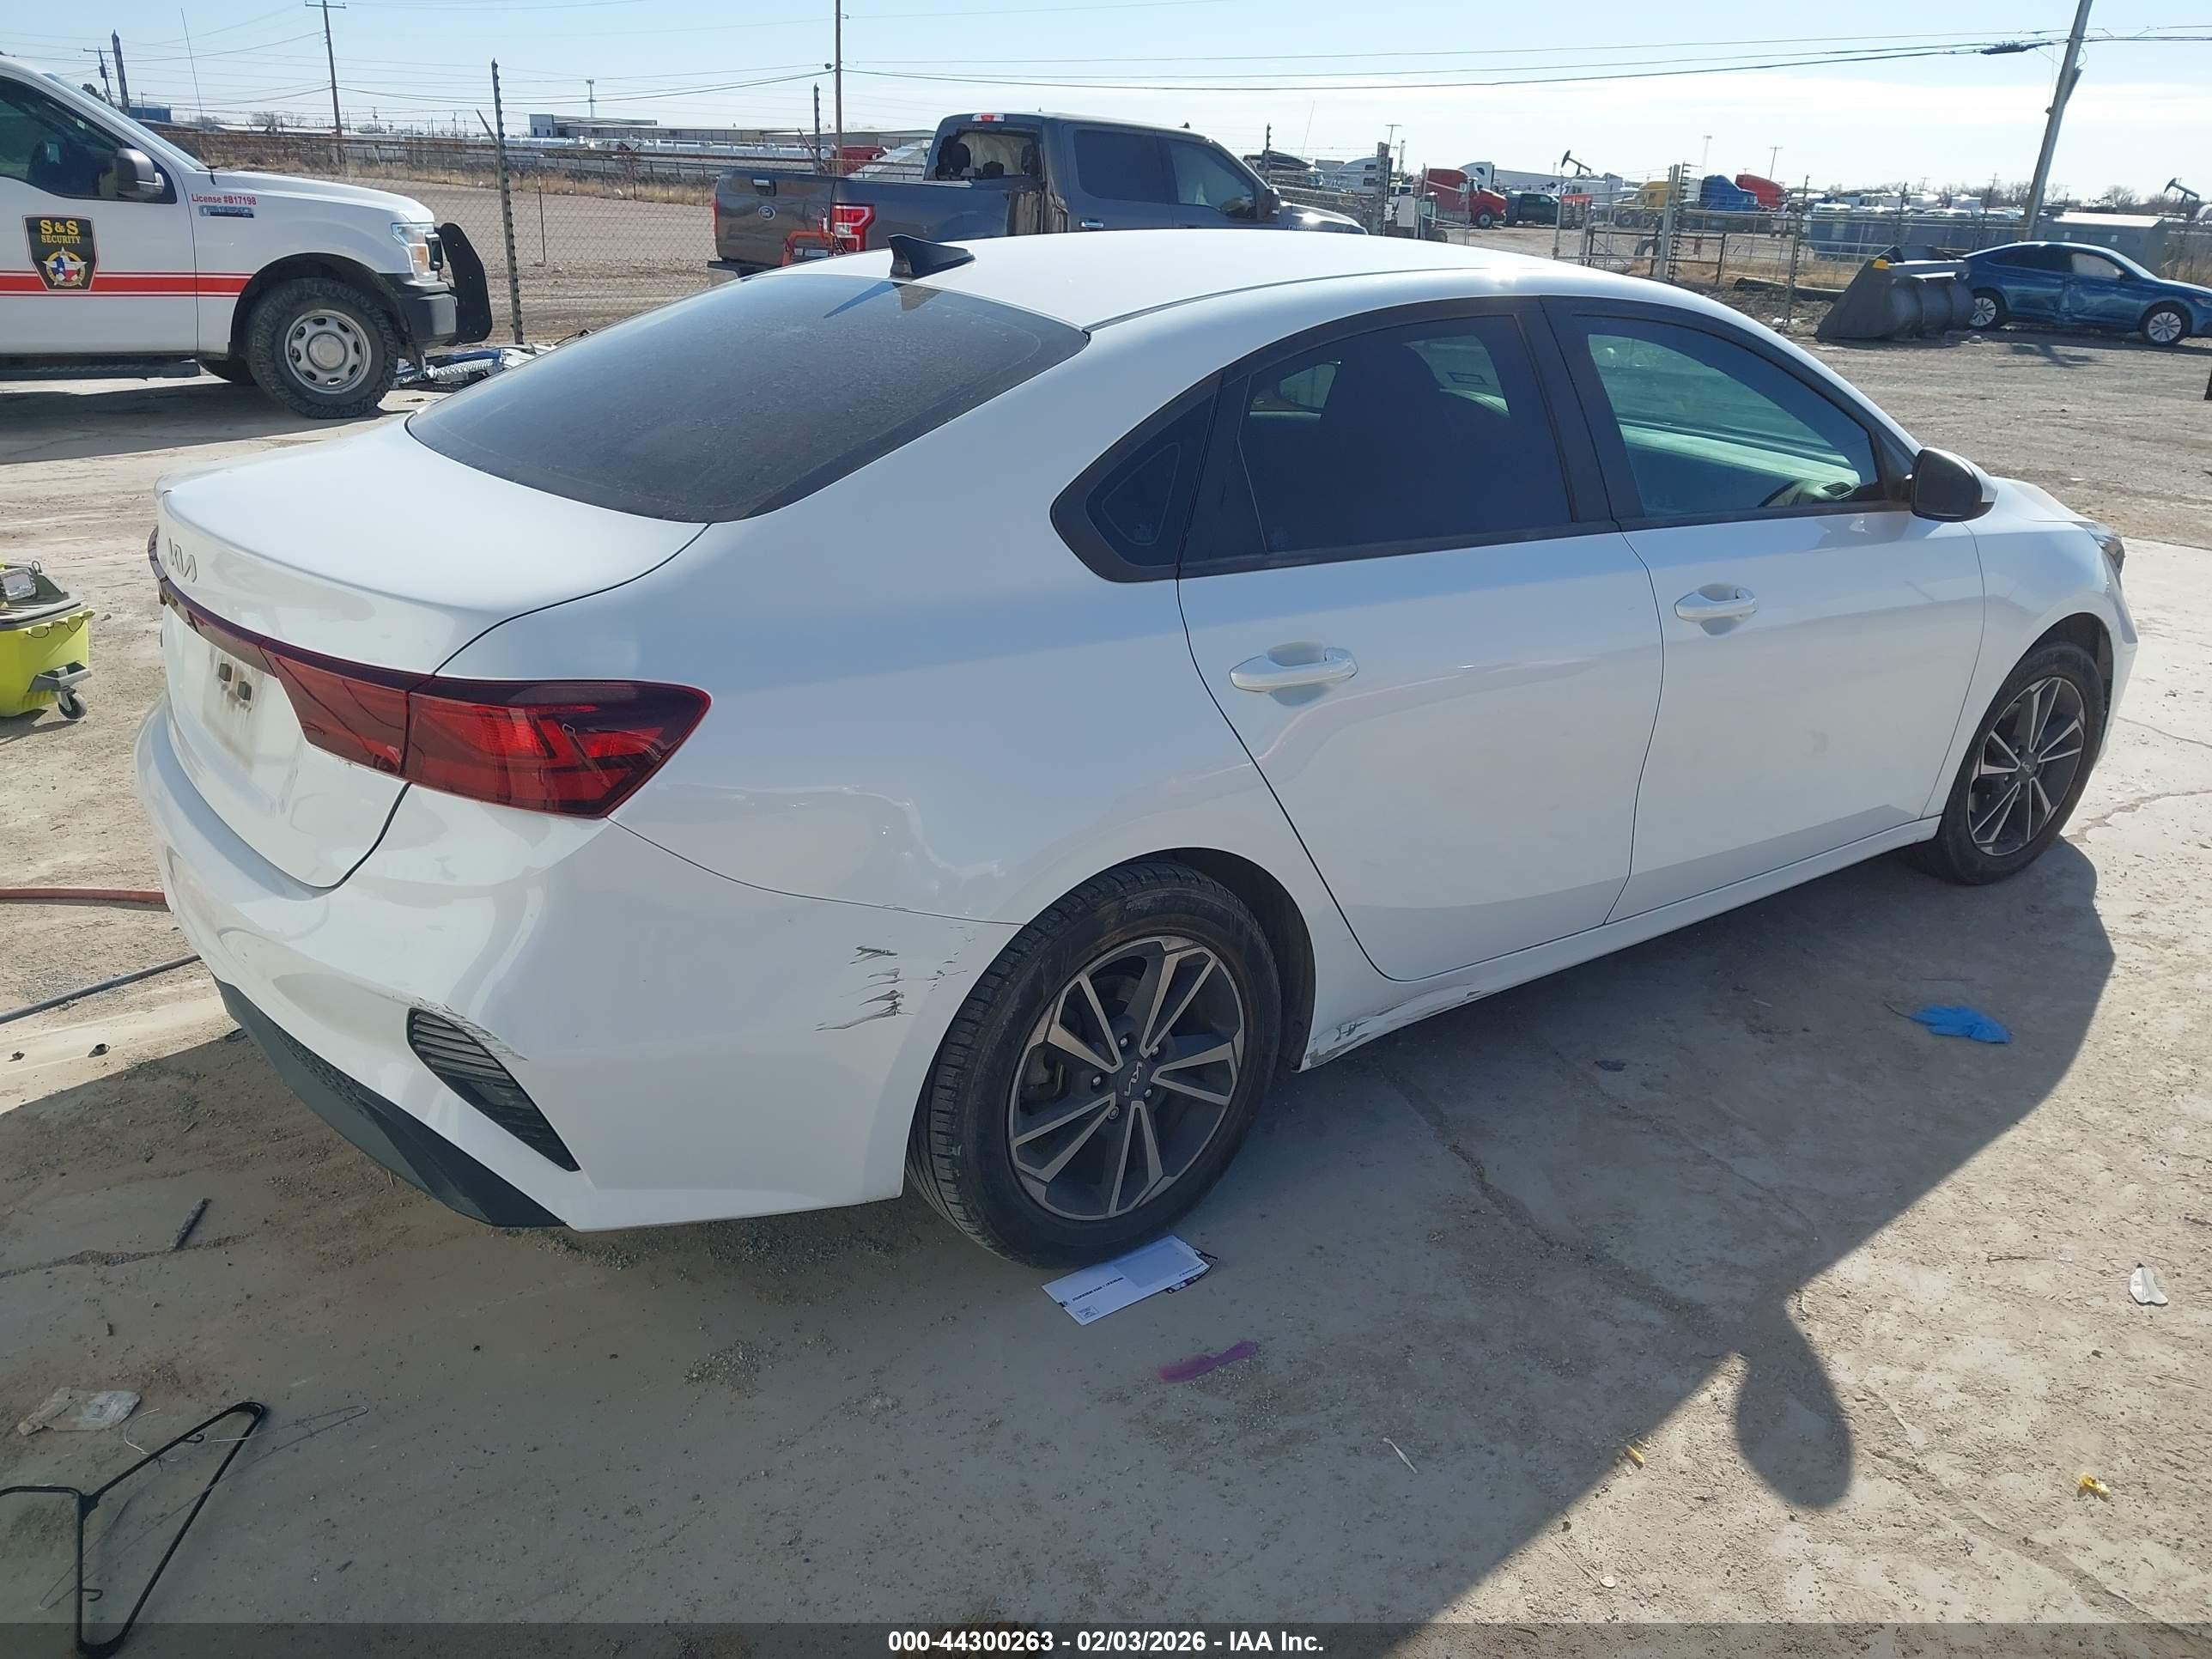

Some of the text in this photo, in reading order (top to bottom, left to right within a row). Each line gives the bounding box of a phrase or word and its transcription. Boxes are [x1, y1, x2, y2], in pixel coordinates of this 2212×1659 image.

[191, 193, 257, 205] License #B17198
[40, 234, 81, 244] SECURITY
